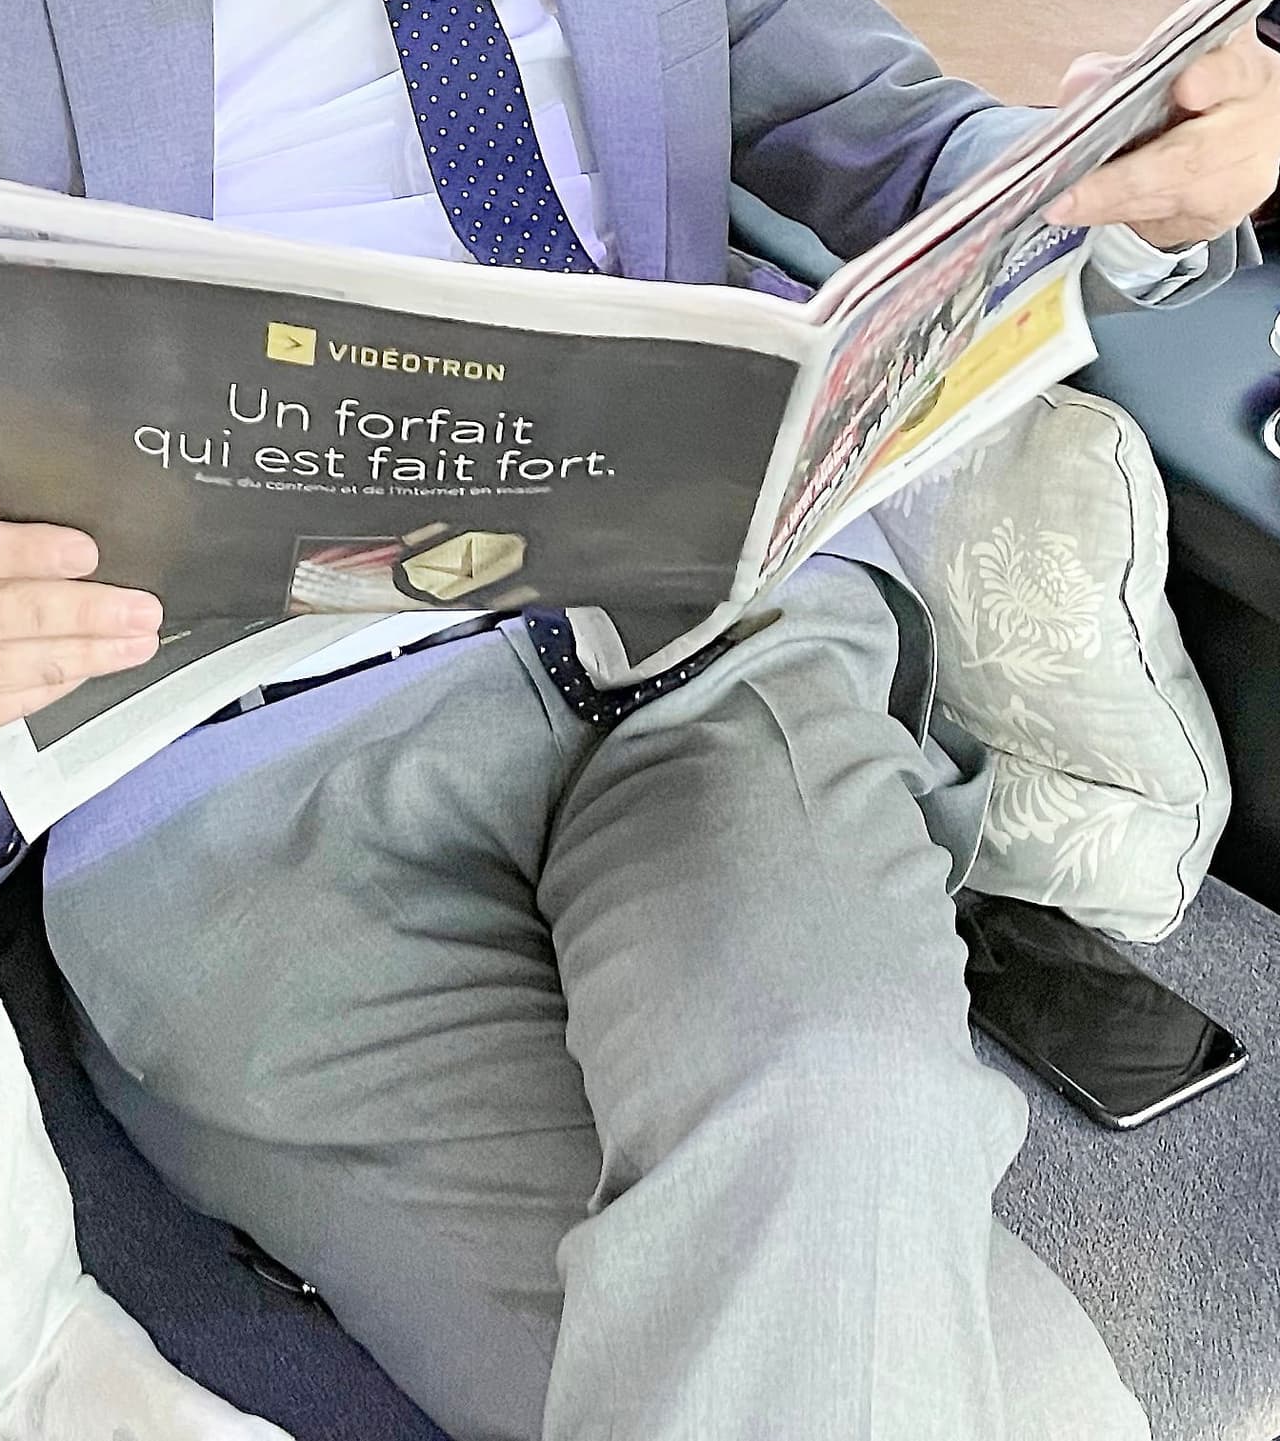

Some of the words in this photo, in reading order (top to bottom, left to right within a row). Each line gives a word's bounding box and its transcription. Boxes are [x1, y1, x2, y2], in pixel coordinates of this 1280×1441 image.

[328, 340, 506, 381] VIDÉOTRON
[227, 382, 310, 431] Un
[335, 398, 534, 445] forfait
[133, 425, 232, 469] qui
[254, 444, 346, 478] est
[368, 446, 475, 482] fait
[497, 449, 616, 481] fort.
